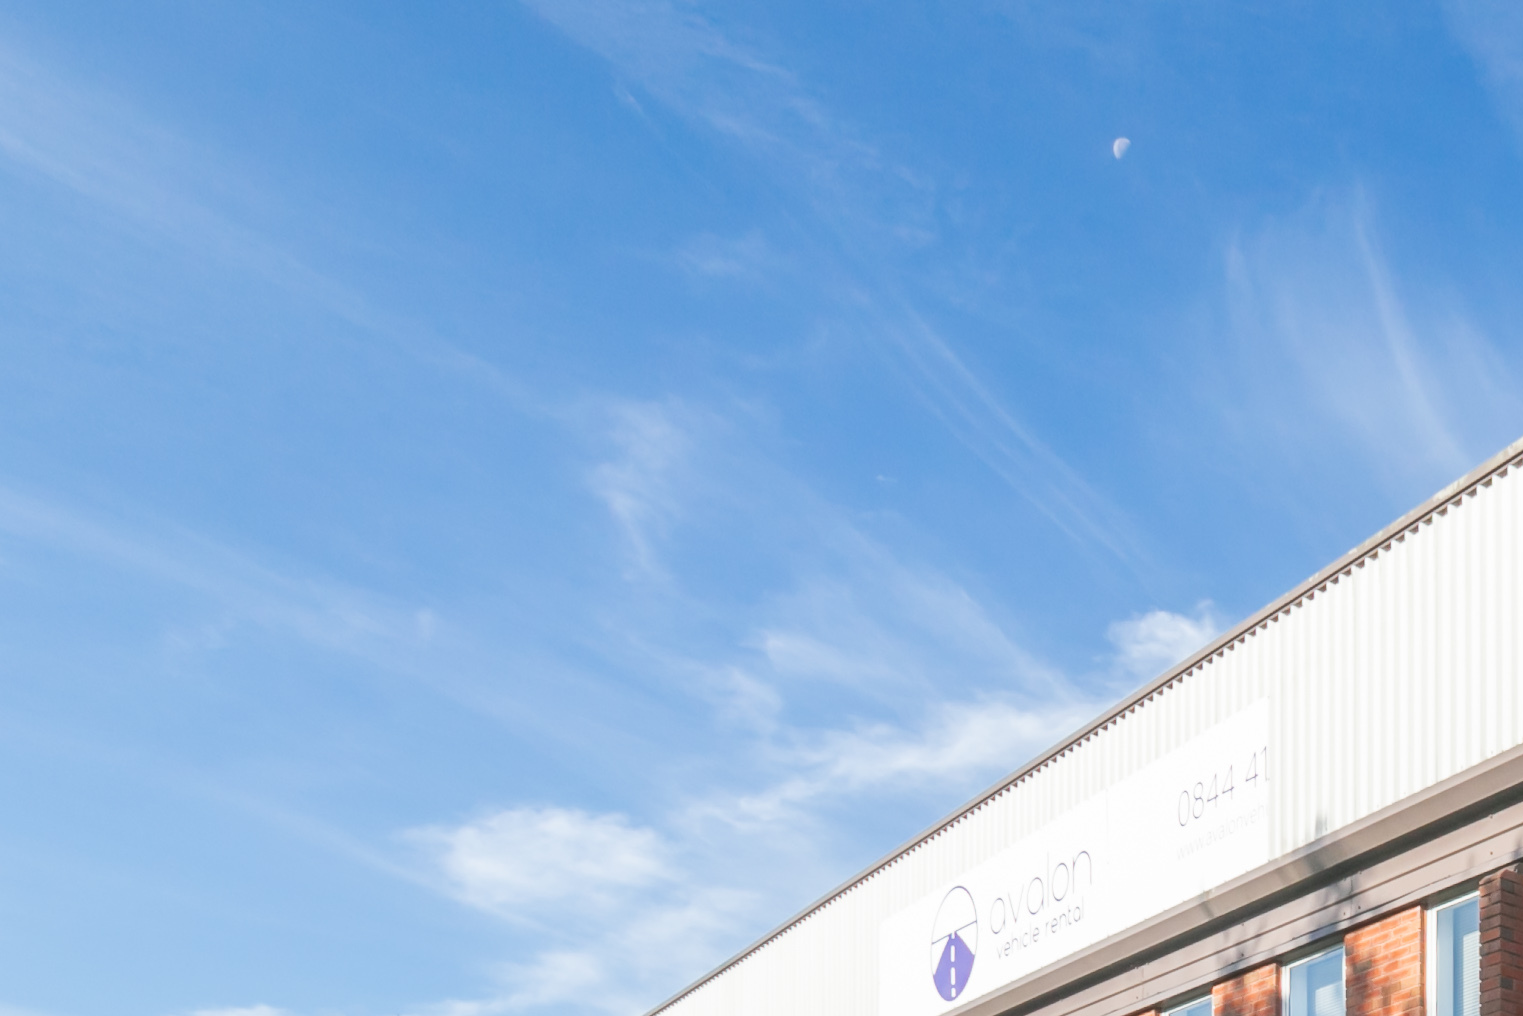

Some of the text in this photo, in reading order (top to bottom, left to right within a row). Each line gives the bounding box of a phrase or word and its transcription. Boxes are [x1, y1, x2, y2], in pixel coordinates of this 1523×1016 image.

[1178, 764, 1235, 827] 0844
[990, 850, 1093, 935] avalon
[996, 895, 1085, 960] vehicle rental
